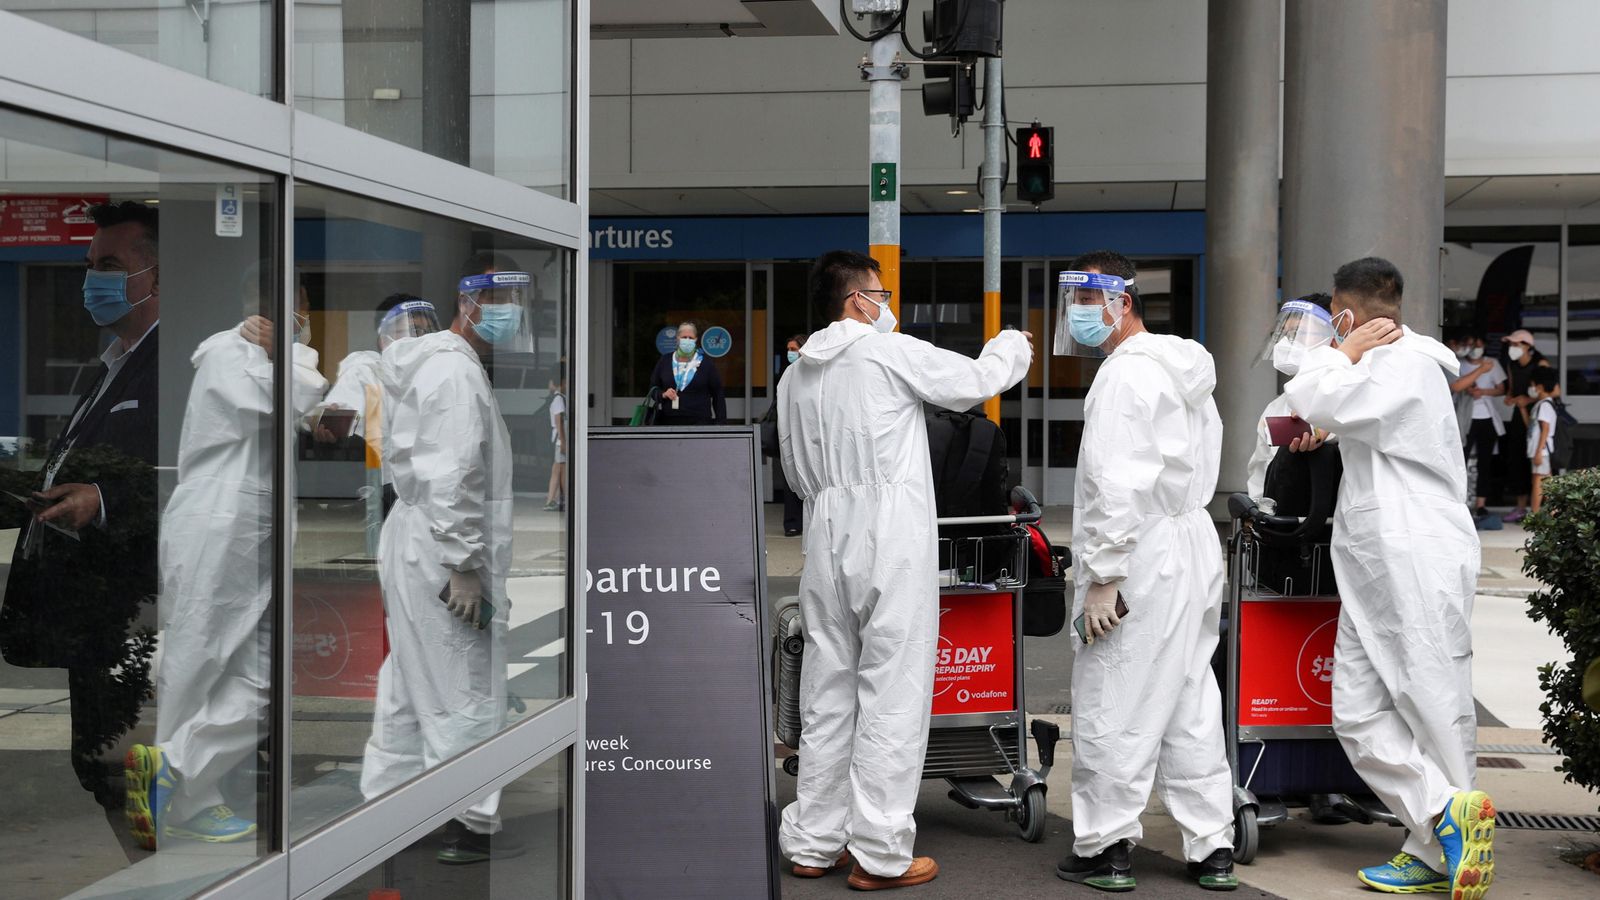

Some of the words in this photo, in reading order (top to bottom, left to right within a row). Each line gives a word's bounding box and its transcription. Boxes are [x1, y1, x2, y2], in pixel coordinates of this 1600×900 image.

[585, 610, 650, 645] -19
[954, 646, 993, 664] DAY
[965, 664, 996, 673] EXPIRY
[971, 689, 1007, 699] vodafone
[586, 735, 630, 751] week
[621, 755, 712, 772] Concourse
